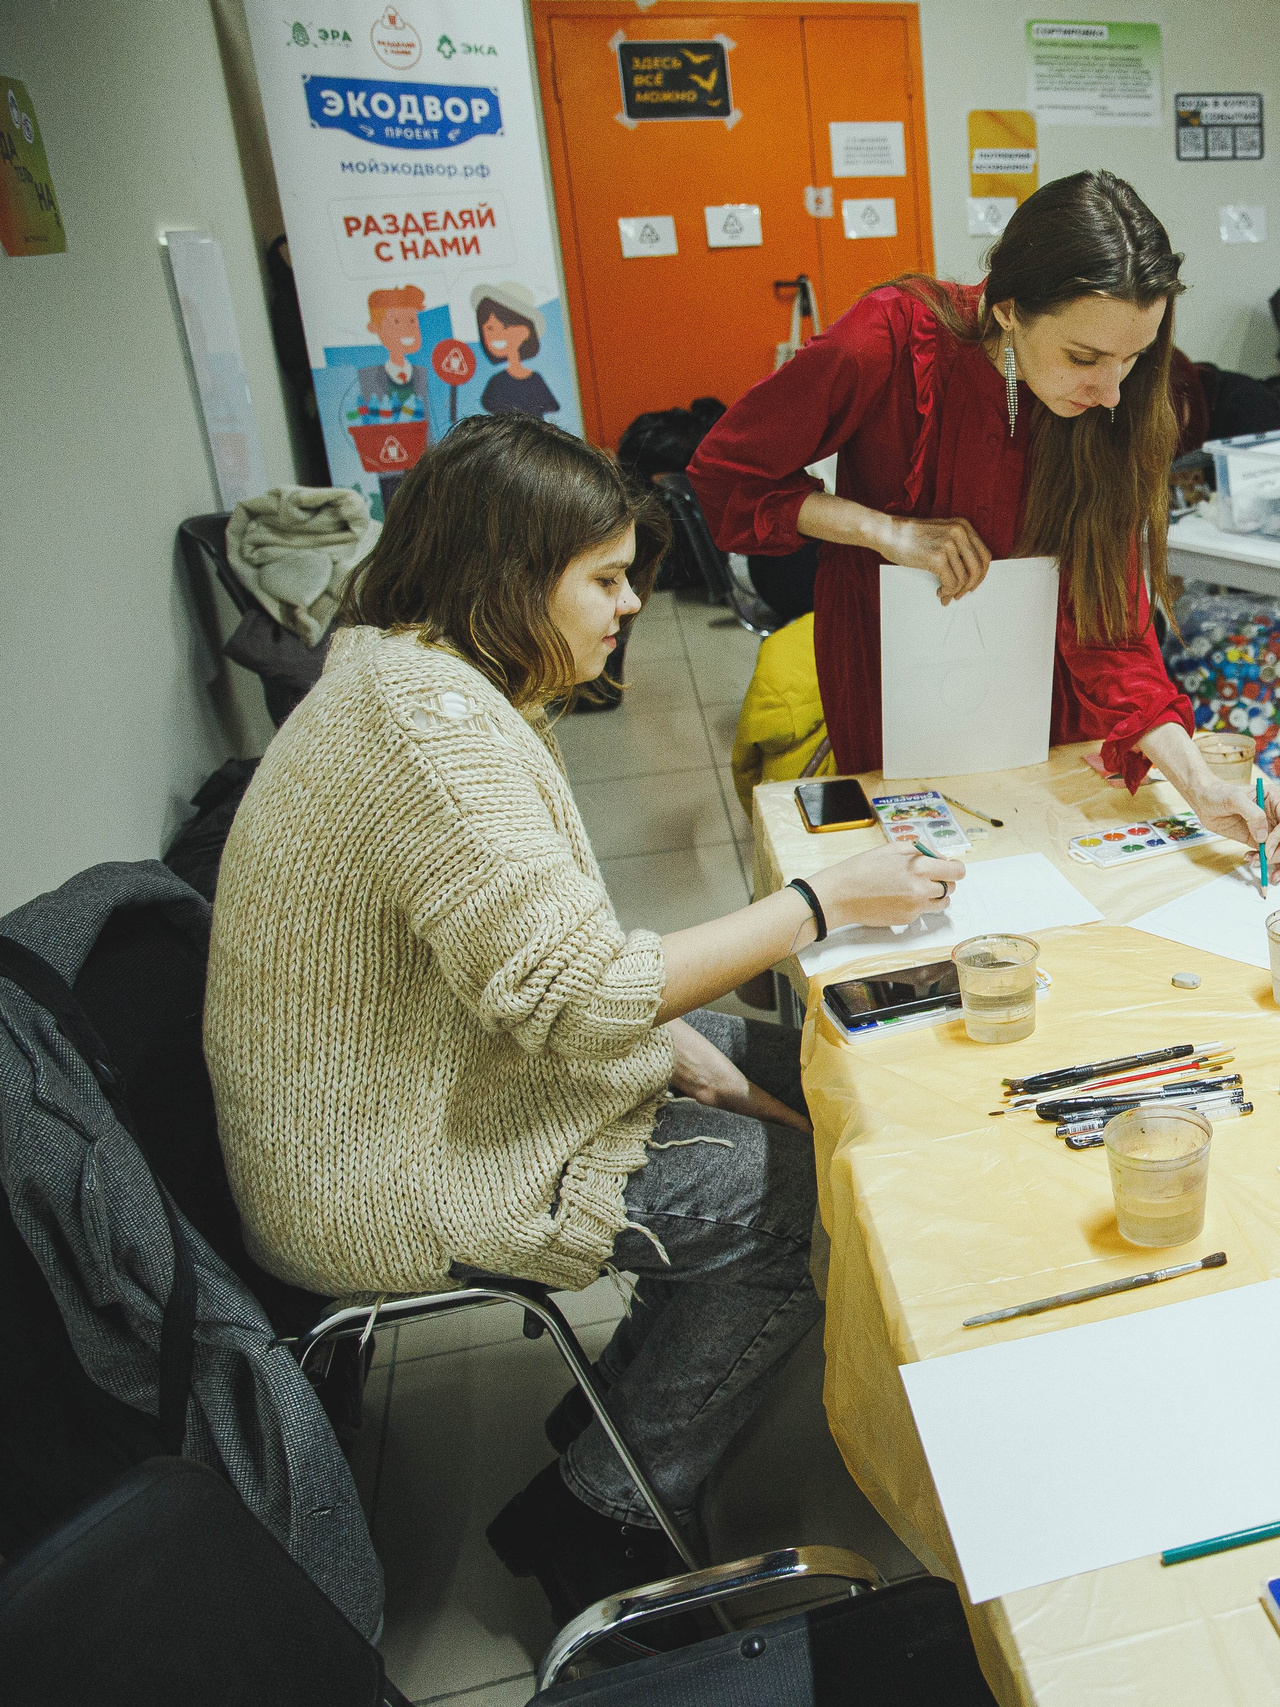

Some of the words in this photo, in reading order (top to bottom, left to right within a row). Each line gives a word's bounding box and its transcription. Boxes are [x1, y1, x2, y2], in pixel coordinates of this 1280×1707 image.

[317, 28, 352, 42] ЭРА
[461, 42, 498, 57] ЭКА
[631, 56, 682, 71] ЗДЕСЬ
[633, 72, 665, 87] ВСЁ
[635, 89, 698, 104] МОЖНО
[319, 89, 491, 125] ЭКОДВОР
[384, 126, 439, 140] ПРОЕКТ
[340, 158, 491, 179] мойэкодвор.рф
[342, 203, 497, 238] РАЗДЕЛЯЙ
[374, 242, 394, 263] С
[399, 235, 482, 262] НАМИ
